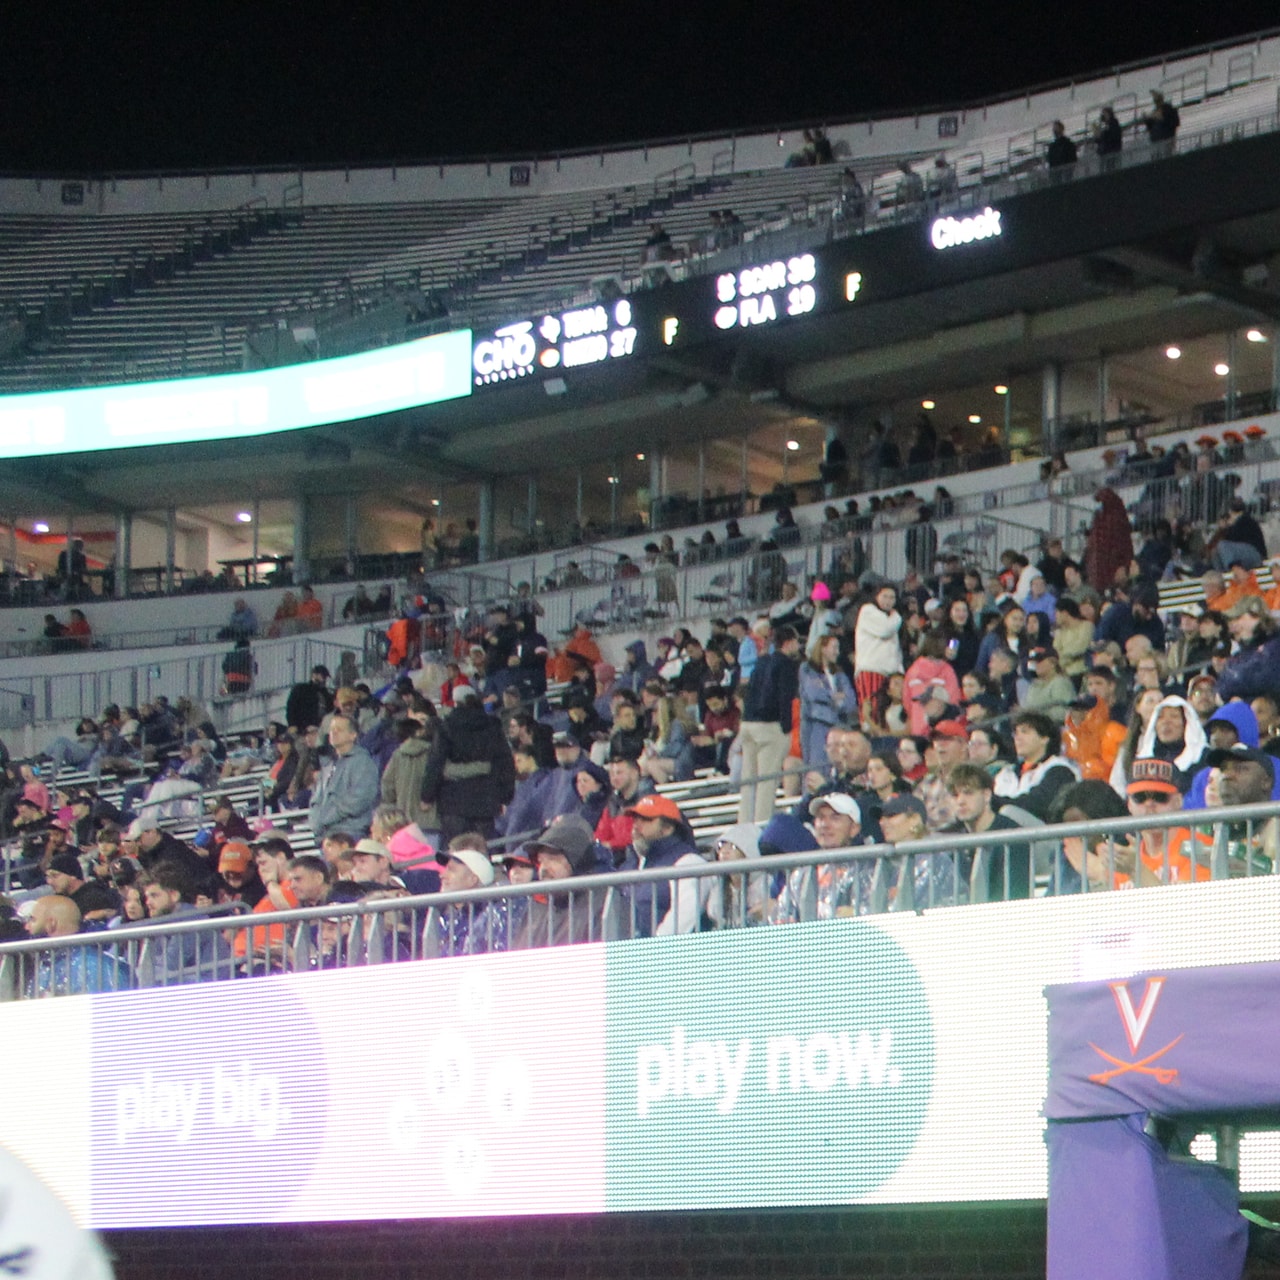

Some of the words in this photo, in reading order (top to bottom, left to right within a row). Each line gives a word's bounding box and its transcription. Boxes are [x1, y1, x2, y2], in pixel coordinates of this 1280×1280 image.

[846, 272, 861, 301] F
[740, 295, 776, 326] FLA
[610, 328, 636, 357] 27
[664, 318, 678, 344] F
[474, 334, 536, 374] CHO
[636, 1026, 752, 1118] play
[766, 1027, 902, 1095] now.
[116, 1071, 201, 1145] play
